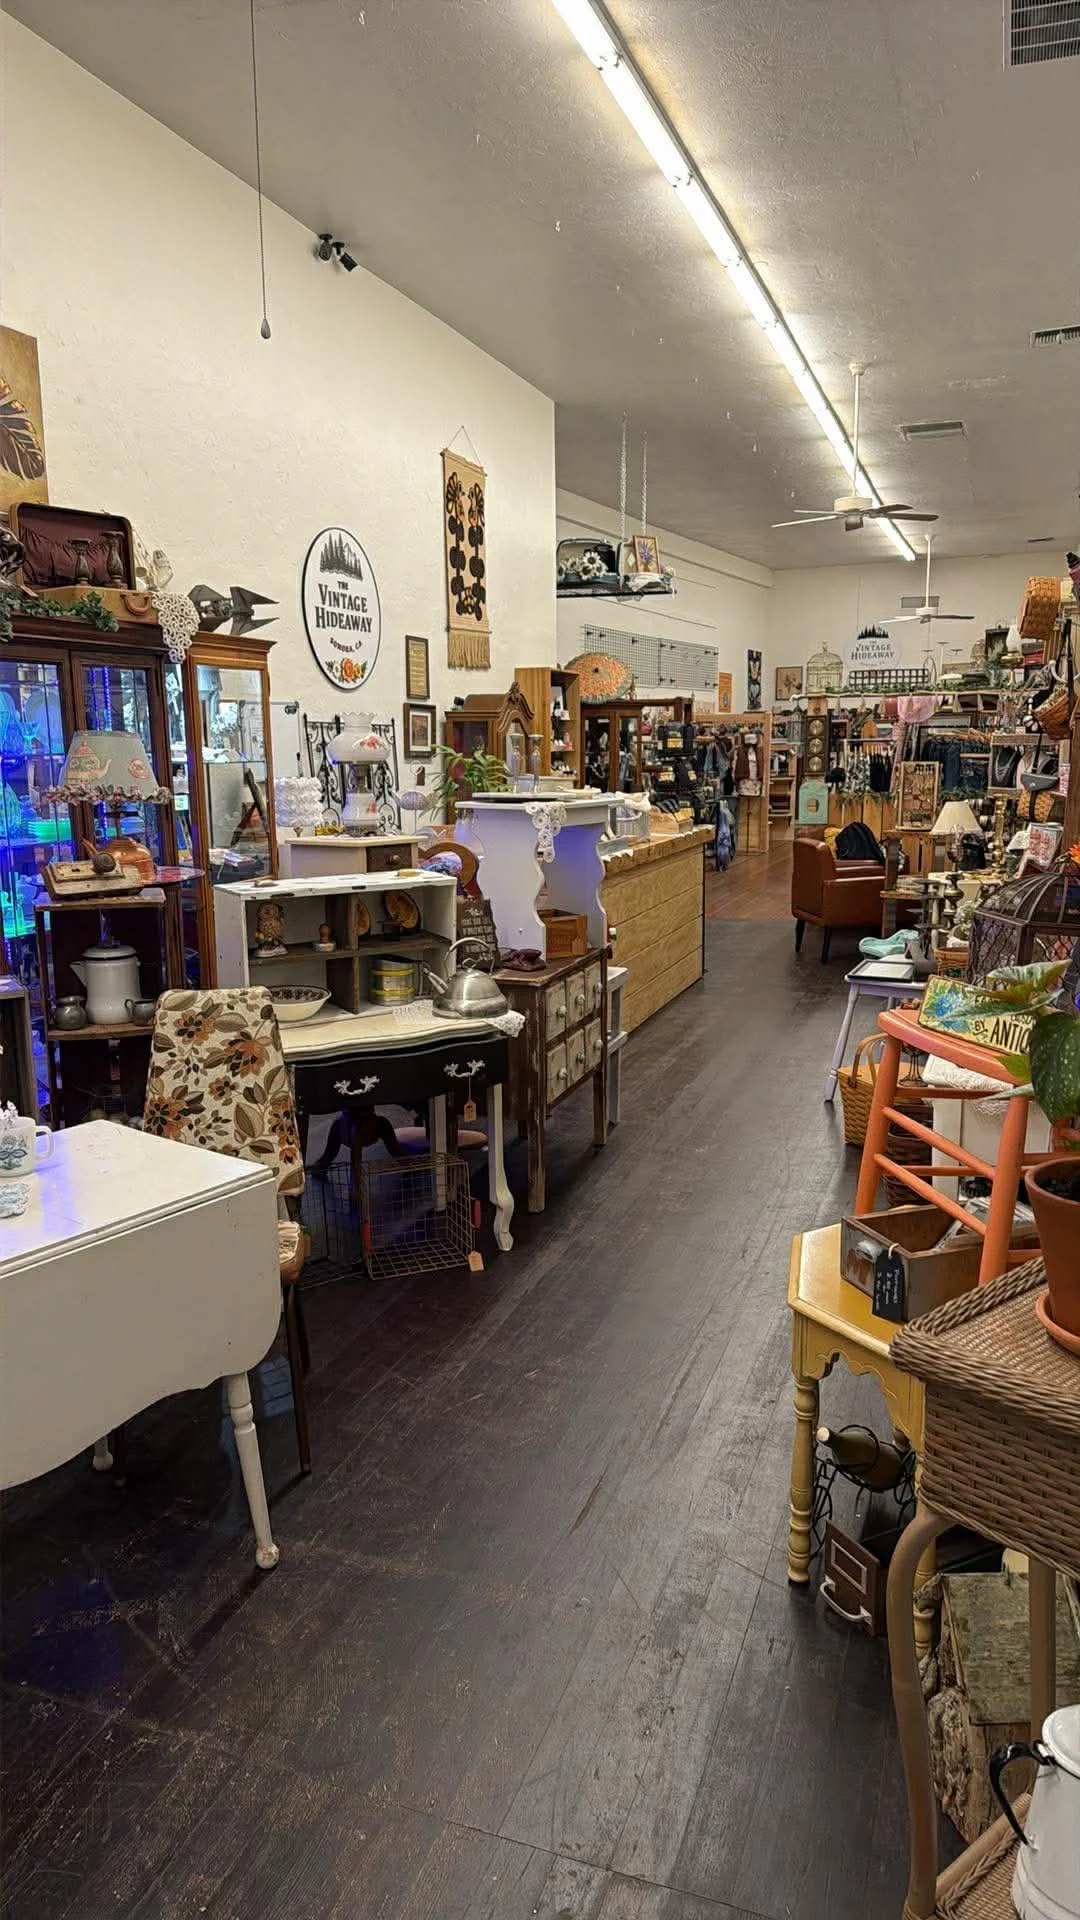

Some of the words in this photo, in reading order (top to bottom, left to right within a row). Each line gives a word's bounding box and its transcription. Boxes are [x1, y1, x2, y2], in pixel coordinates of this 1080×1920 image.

[337, 581, 349, 590] THE
[318, 583, 368, 613] VINTAGE
[315, 606, 373, 633] HIDEAWAY
[855, 643, 891, 652] VINTAGE
[851, 651, 895, 660] HIDEAWAY
